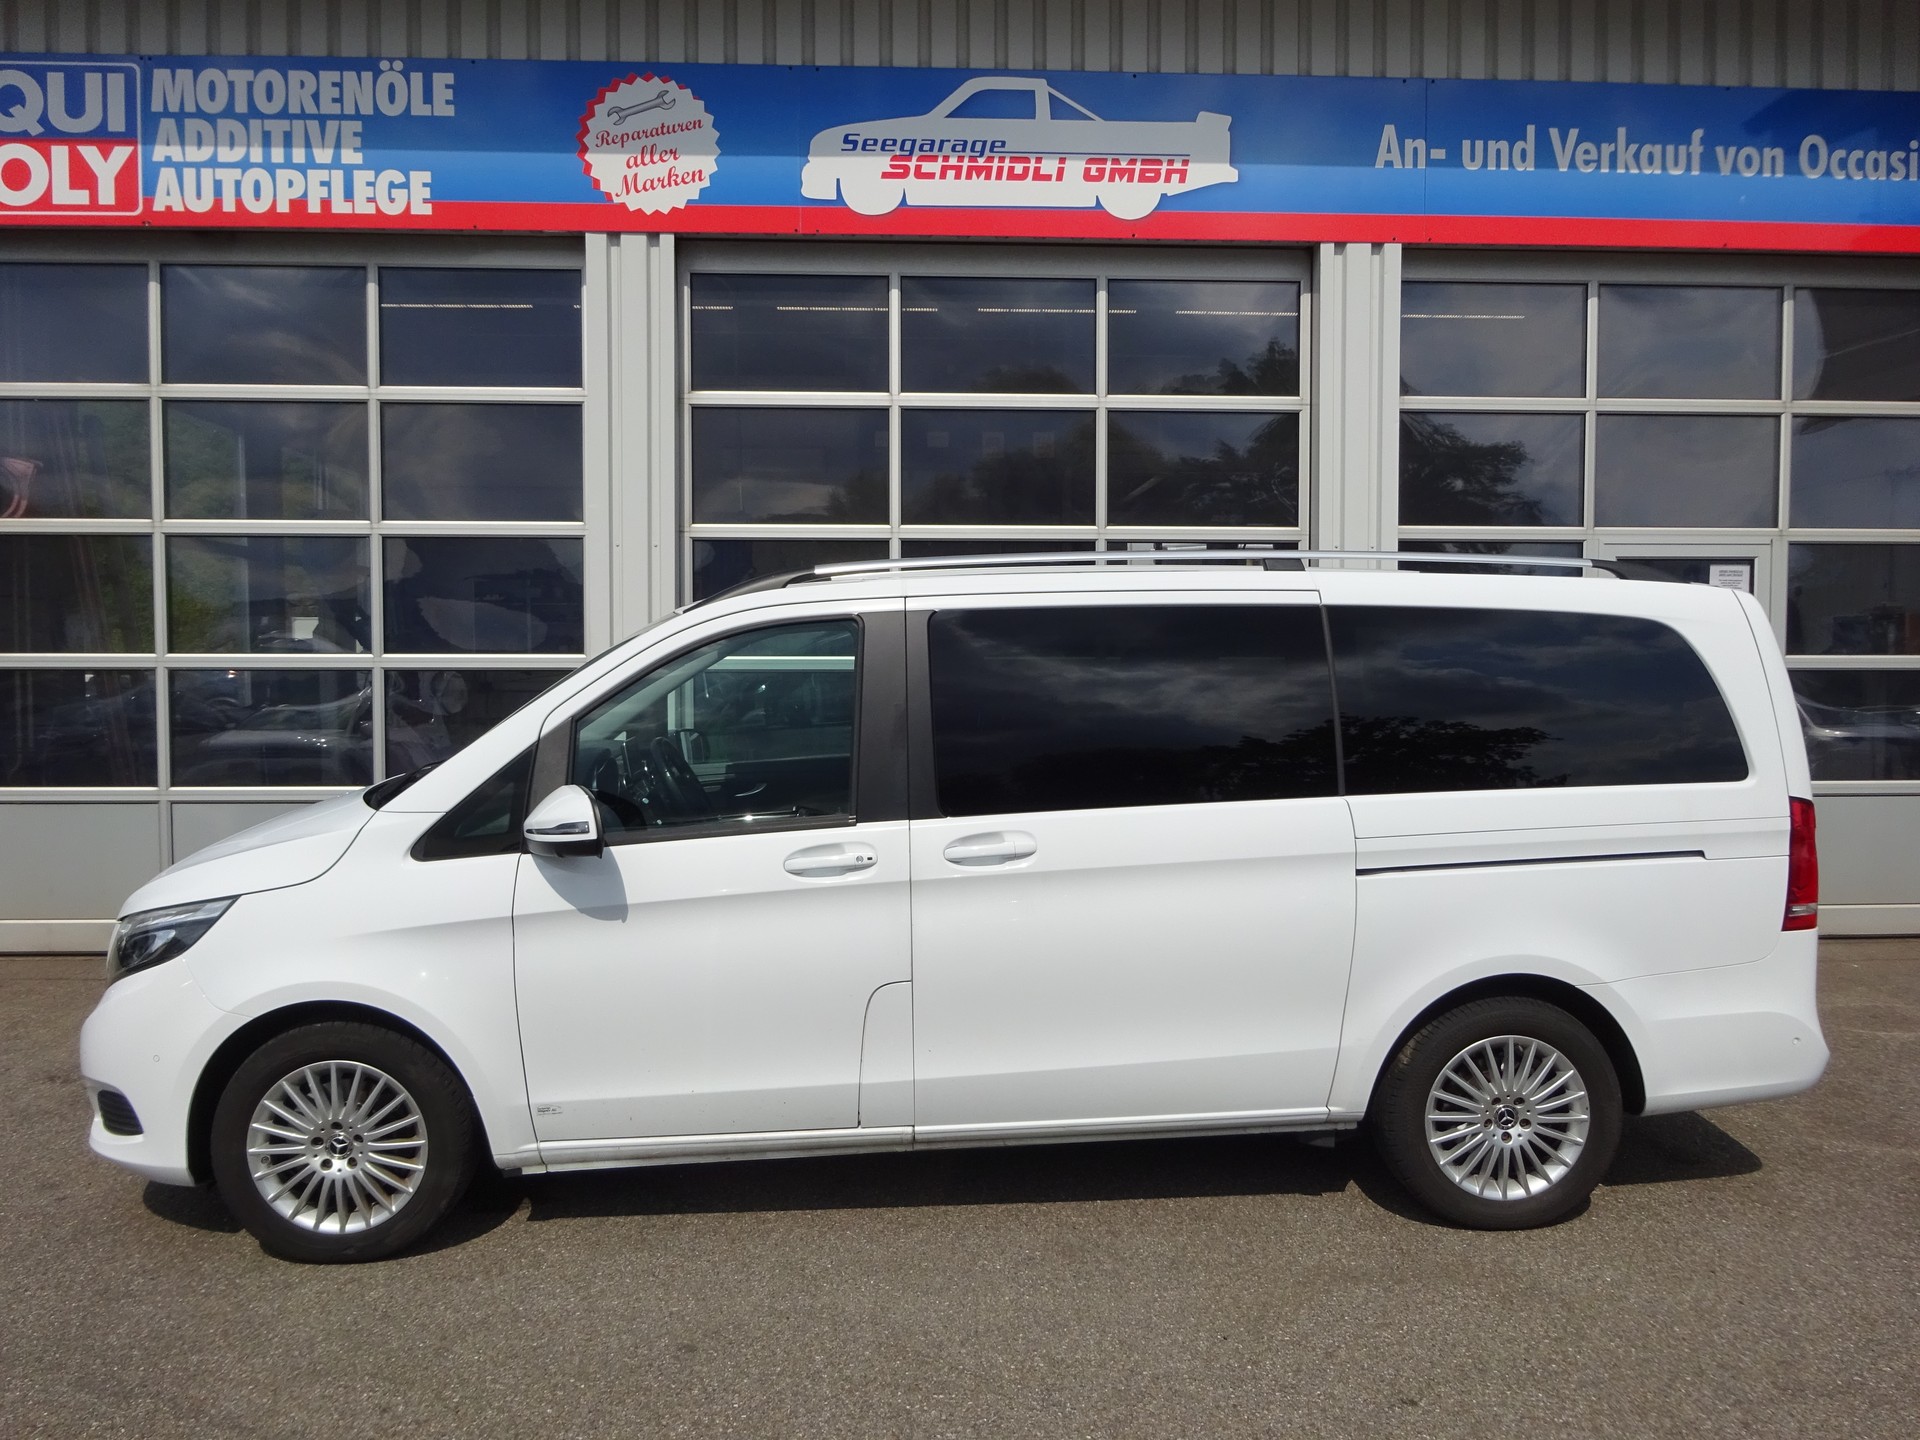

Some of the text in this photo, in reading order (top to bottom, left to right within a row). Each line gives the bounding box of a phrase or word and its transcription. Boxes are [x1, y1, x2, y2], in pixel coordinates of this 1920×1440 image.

[151, 60, 455, 116] MOTORENÖLE
[152, 118, 363, 164] ADDITIVE
[595, 118, 704, 148] Reparaturen
[841, 133, 1006, 156] Seegarage
[626, 143, 680, 169] aller
[1374, 124, 1446, 170] An-
[1461, 125, 1535, 172] und
[1548, 128, 1704, 175] Verkauf
[1715, 145, 1784, 178] von
[615, 166, 705, 197] Marken
[880, 155, 1190, 184] SCHMIDLI GMBH
[152, 167, 432, 214] AUTOPFLEGE
